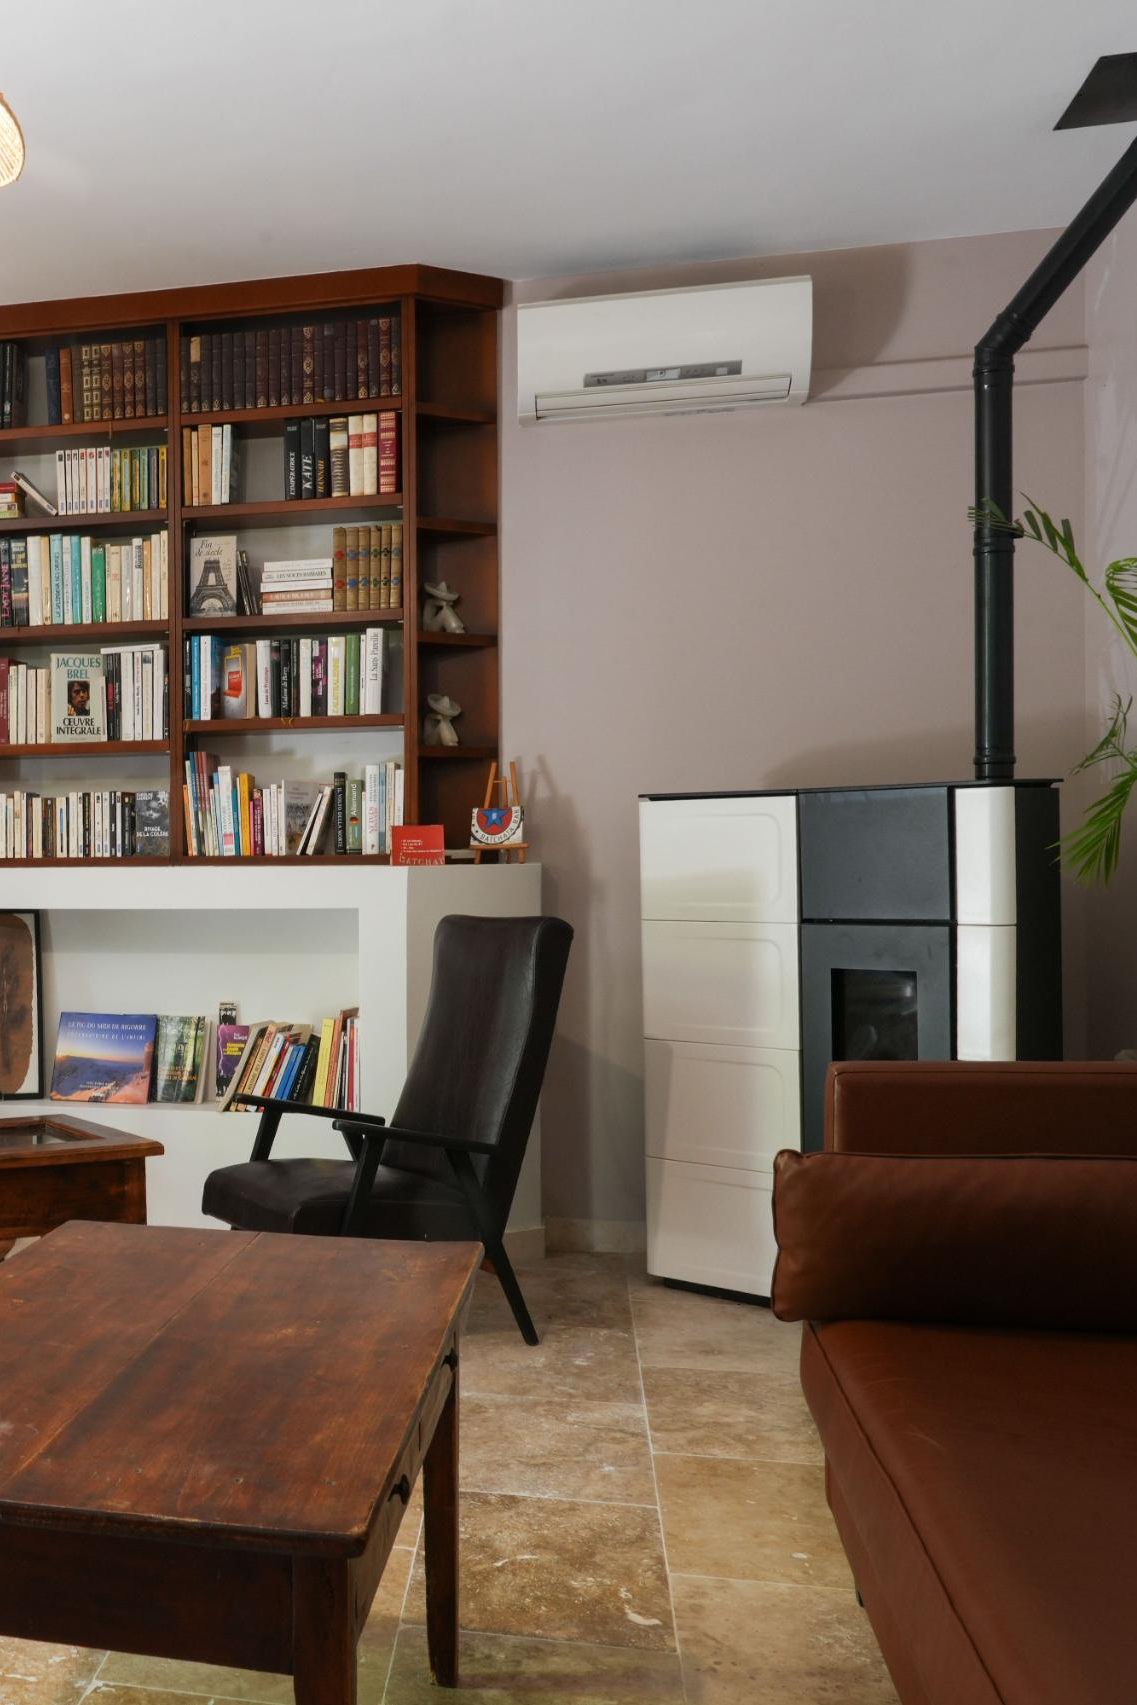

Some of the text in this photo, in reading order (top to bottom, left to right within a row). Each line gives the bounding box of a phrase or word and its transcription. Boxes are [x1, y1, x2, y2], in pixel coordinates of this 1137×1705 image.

[302, 454, 313, 490] KATE
[317, 459, 325, 493] HANNAH
[370, 631, 379, 681] La Sans Pareille
[56, 657, 101, 669] JACQUES
[67, 669, 89, 679] BREL
[63, 717, 95, 727] ŒUVRE
[56, 726, 101, 736] INTEGRALE
[67, 1021, 75, 1029] LE
[76, 1021, 86, 1029] PIC
[87, 1022, 96, 1030] DU
[121, 1023, 147, 1031] BIGORRE
